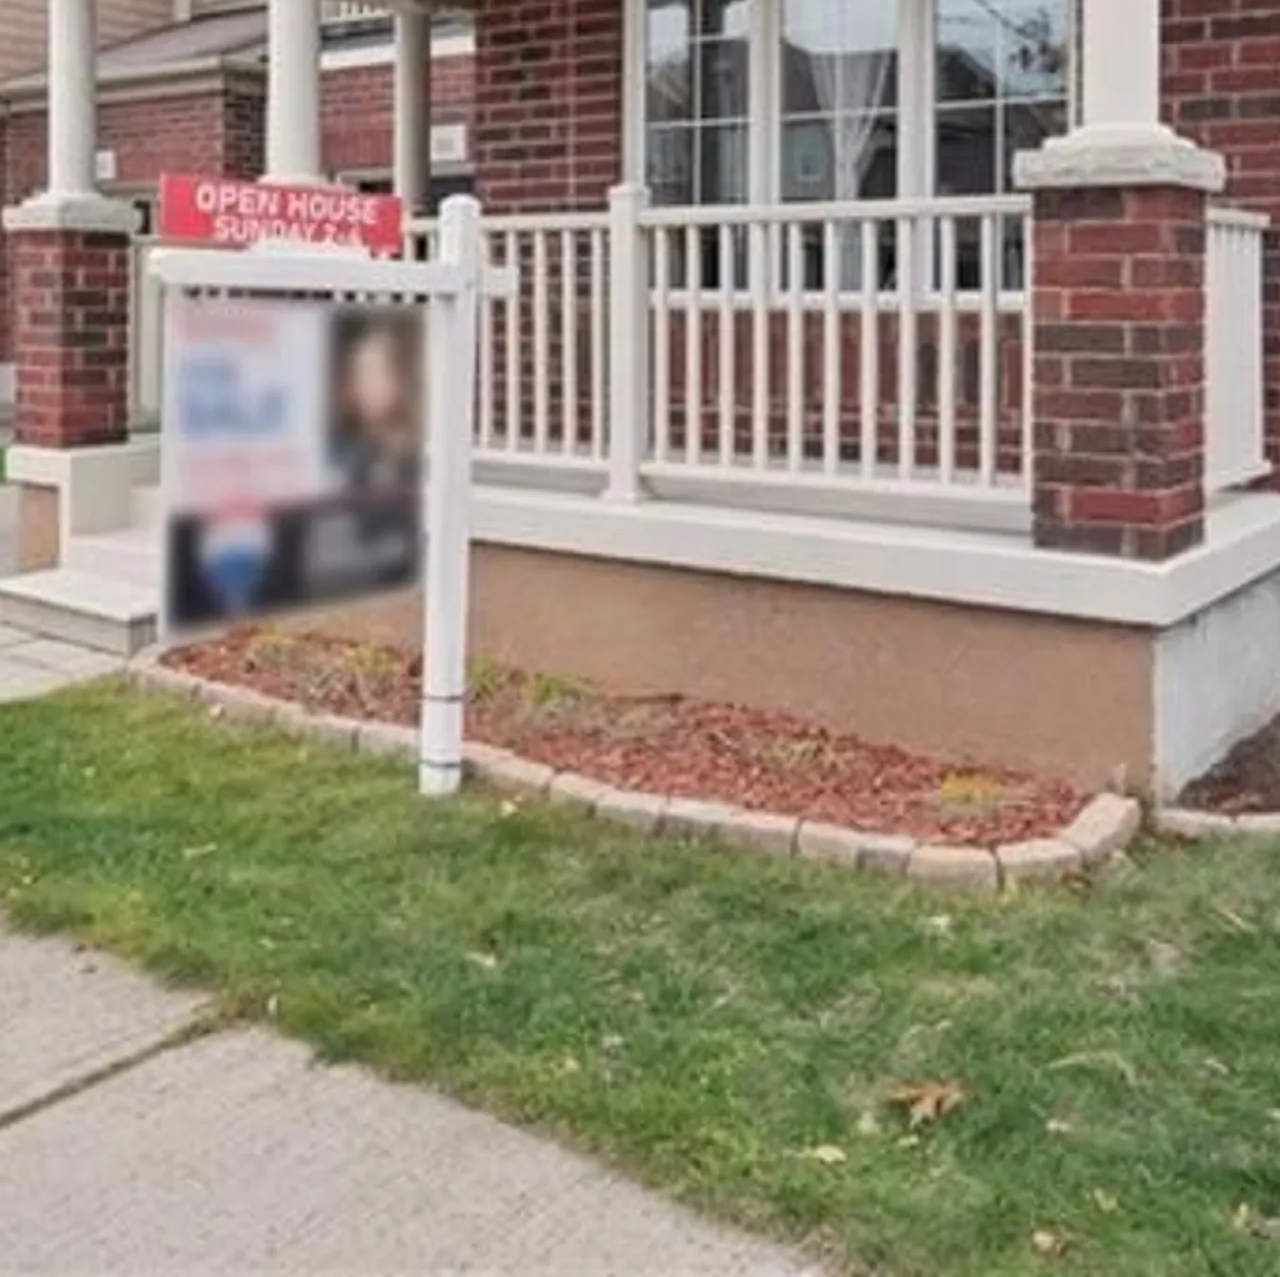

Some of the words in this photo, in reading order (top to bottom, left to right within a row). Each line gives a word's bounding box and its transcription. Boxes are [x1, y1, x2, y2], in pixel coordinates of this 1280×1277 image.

[196, 183, 280, 215] OPEN
[286, 191, 379, 223] HOUSE
[213, 215, 316, 244] SUNDAY
